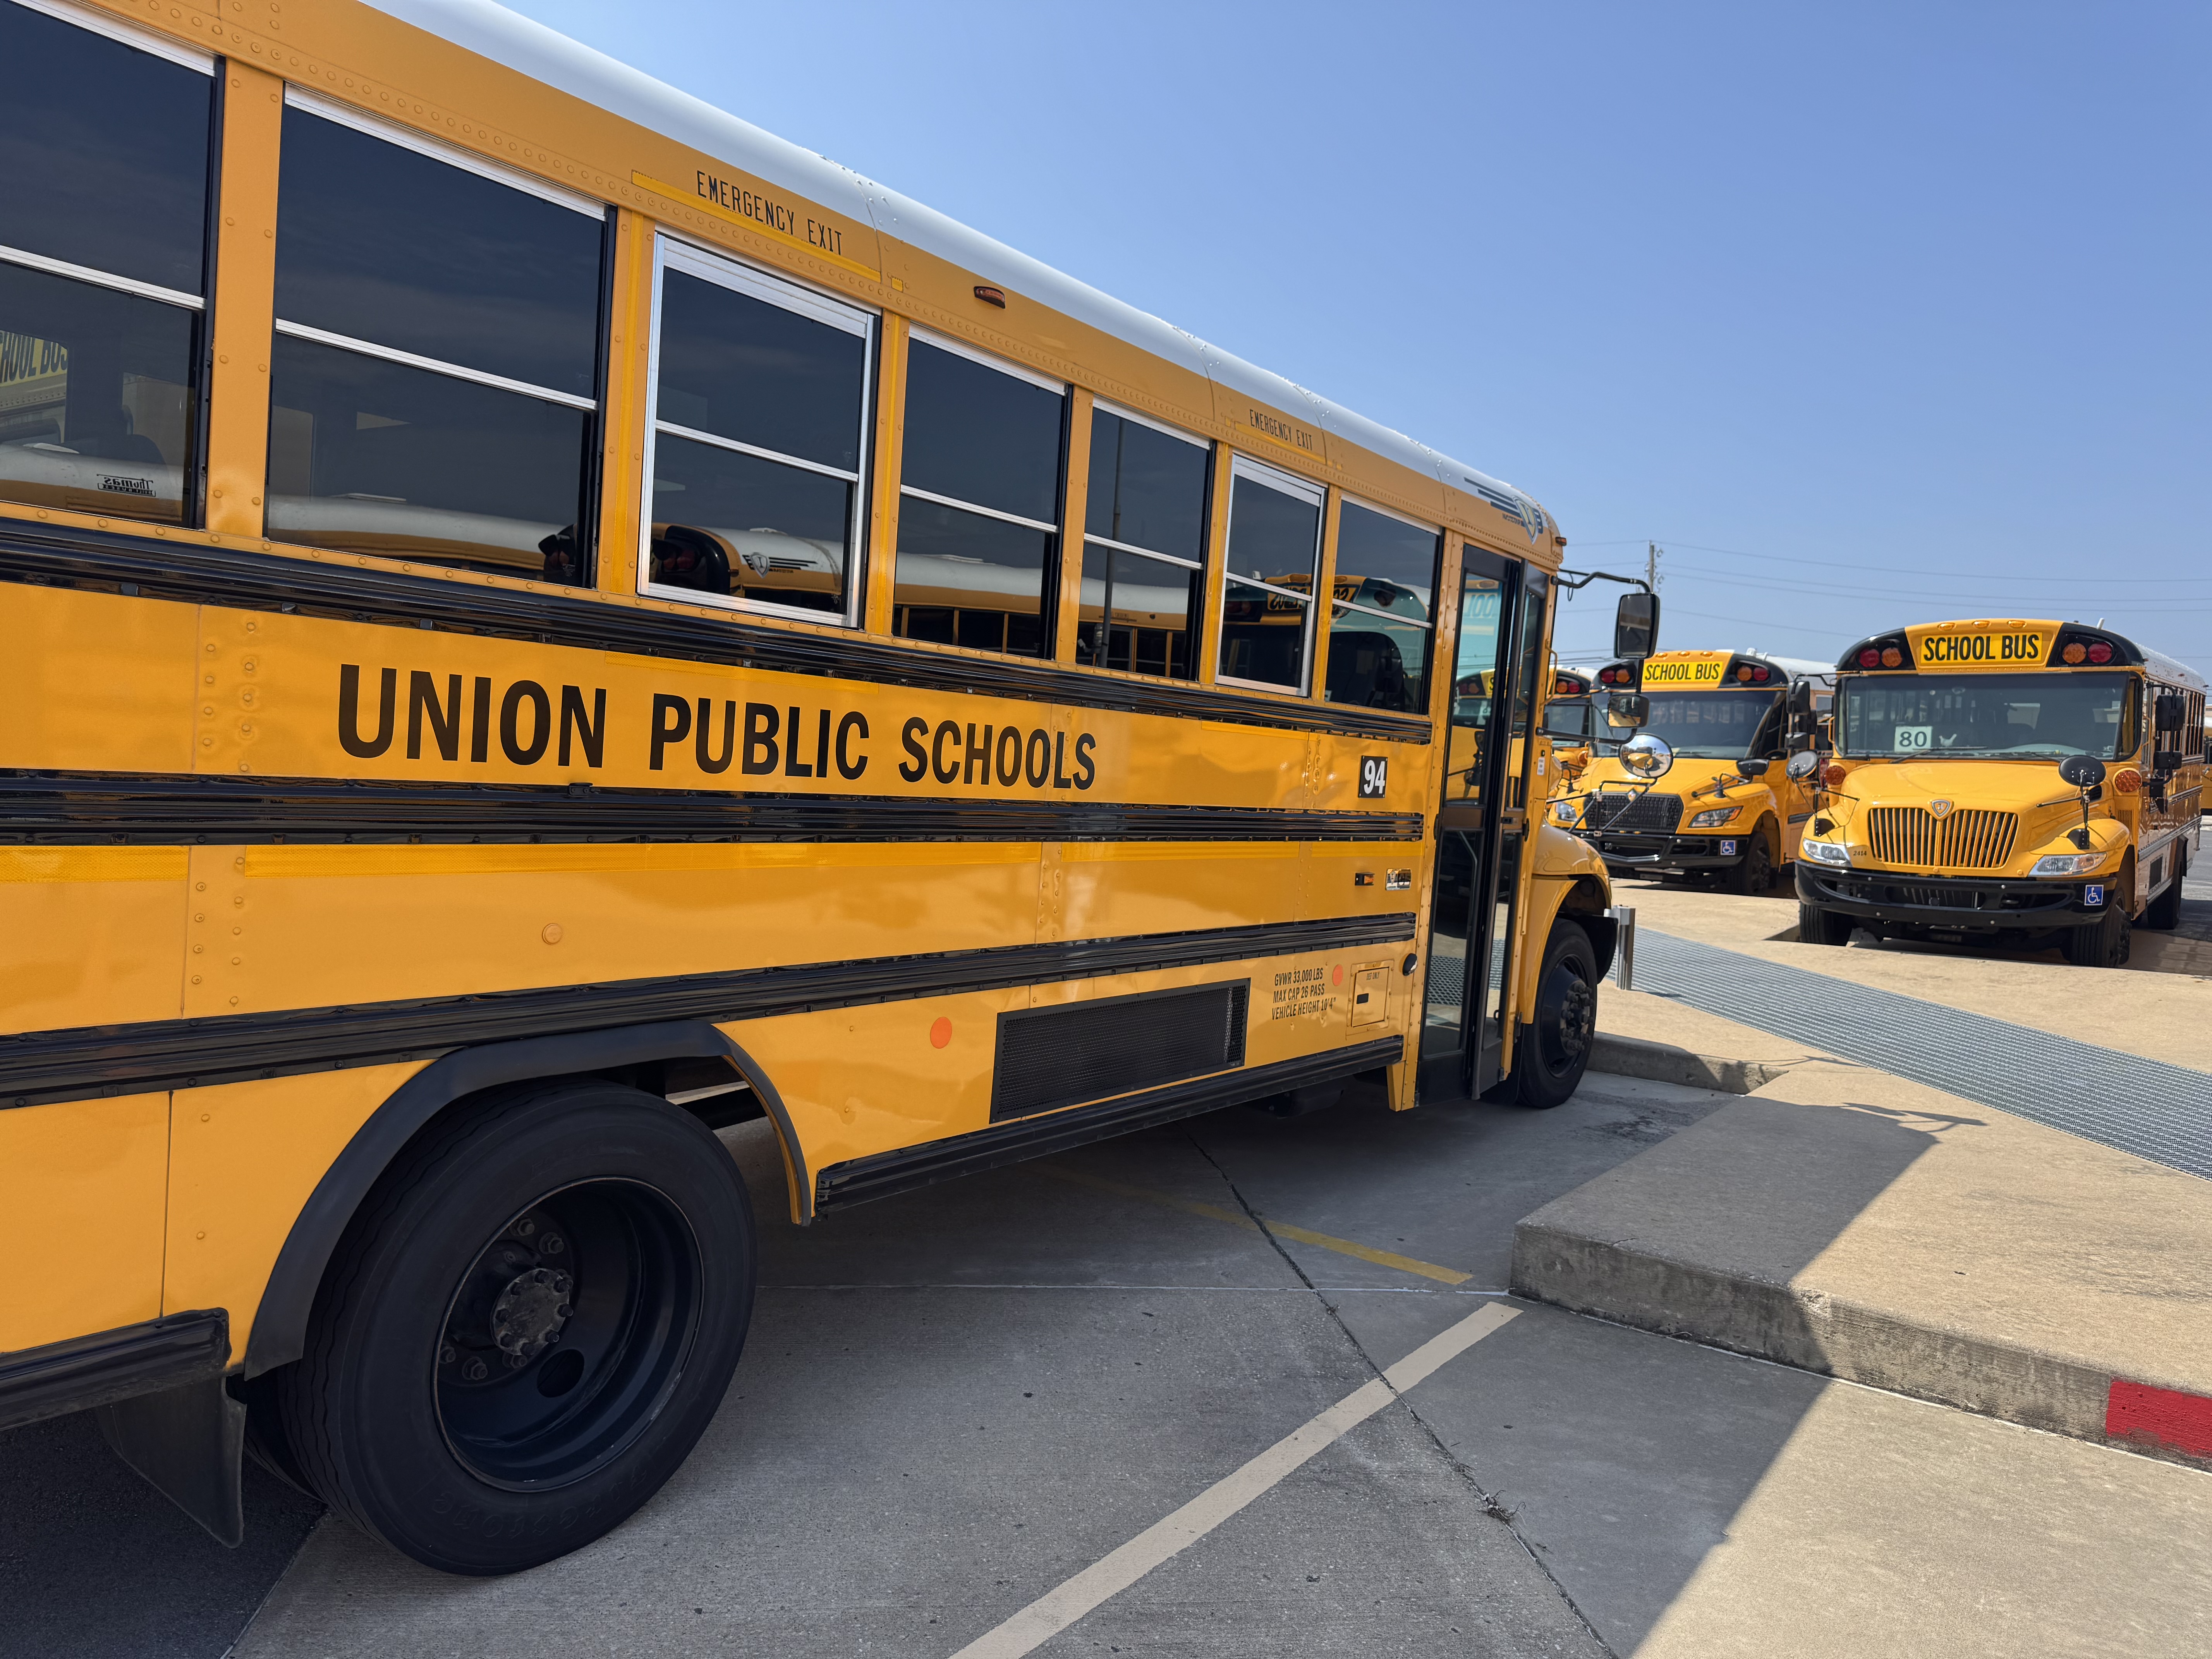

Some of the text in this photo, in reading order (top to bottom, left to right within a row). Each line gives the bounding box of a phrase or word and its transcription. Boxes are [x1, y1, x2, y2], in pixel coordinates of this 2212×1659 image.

[697, 170, 842, 256] EMERGENCY EXIT
[1249, 409, 1312, 451] EMERGENCY EXIT
[1923, 634, 2040, 661] SCHOOL BUS
[1645, 663, 1720, 681] SCHOOL BUS
[338, 663, 1097, 791] UNION PUBLIC SCHOOLS
[1899, 731, 1927, 747] 80
[1364, 759, 1385, 794] 94
[1274, 967, 1323, 986] GVWR 33,000 LBS
[1273, 982, 1325, 1003] MAX CAP 26 PASS
[1272, 996, 1336, 1020] VEHICLE HEIGHT 10'4"
